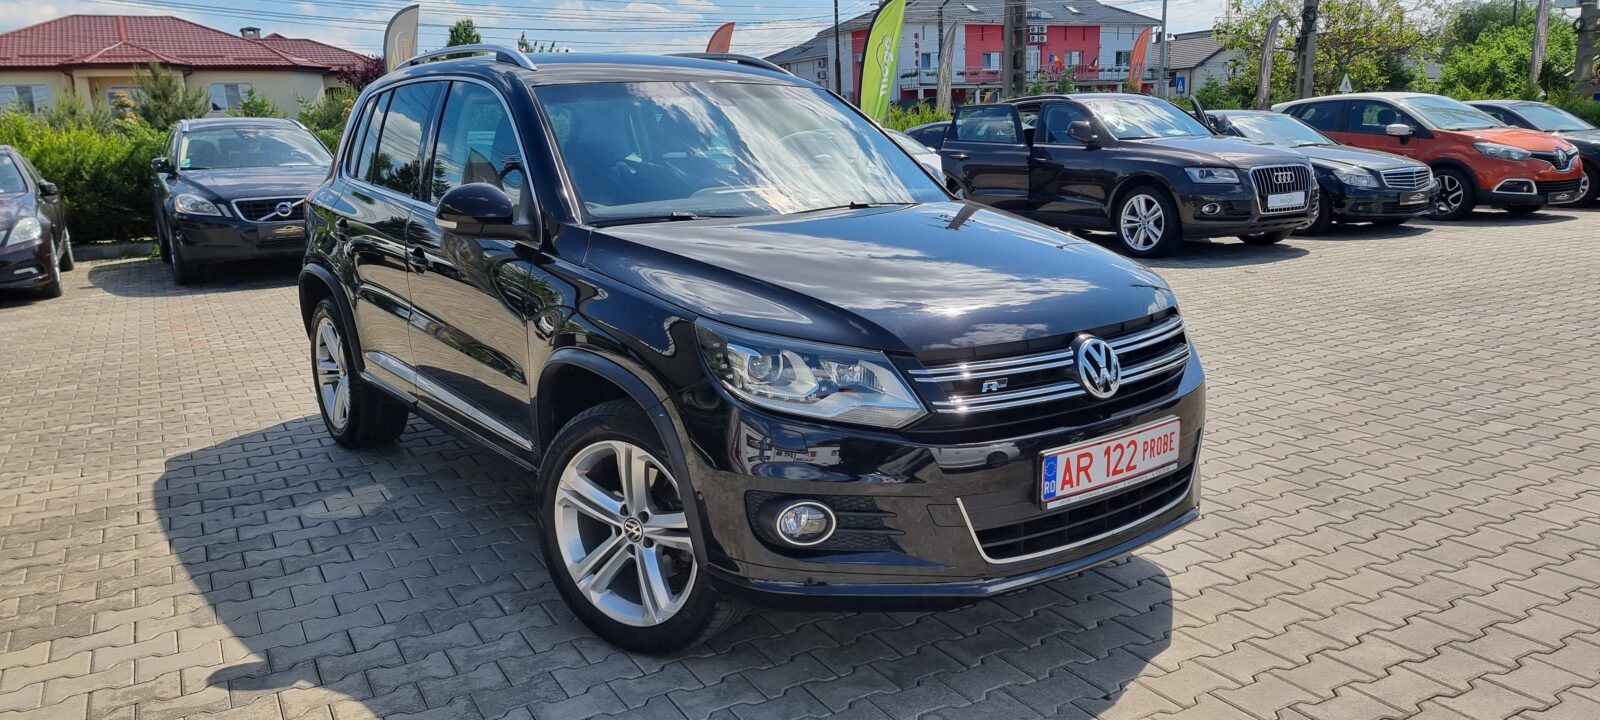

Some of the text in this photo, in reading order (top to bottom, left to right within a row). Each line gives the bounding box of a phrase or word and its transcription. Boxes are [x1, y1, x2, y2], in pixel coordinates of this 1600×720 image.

[1060, 431, 1176, 491] AR 122 PROBE
[1044, 479, 1056, 495] RO
